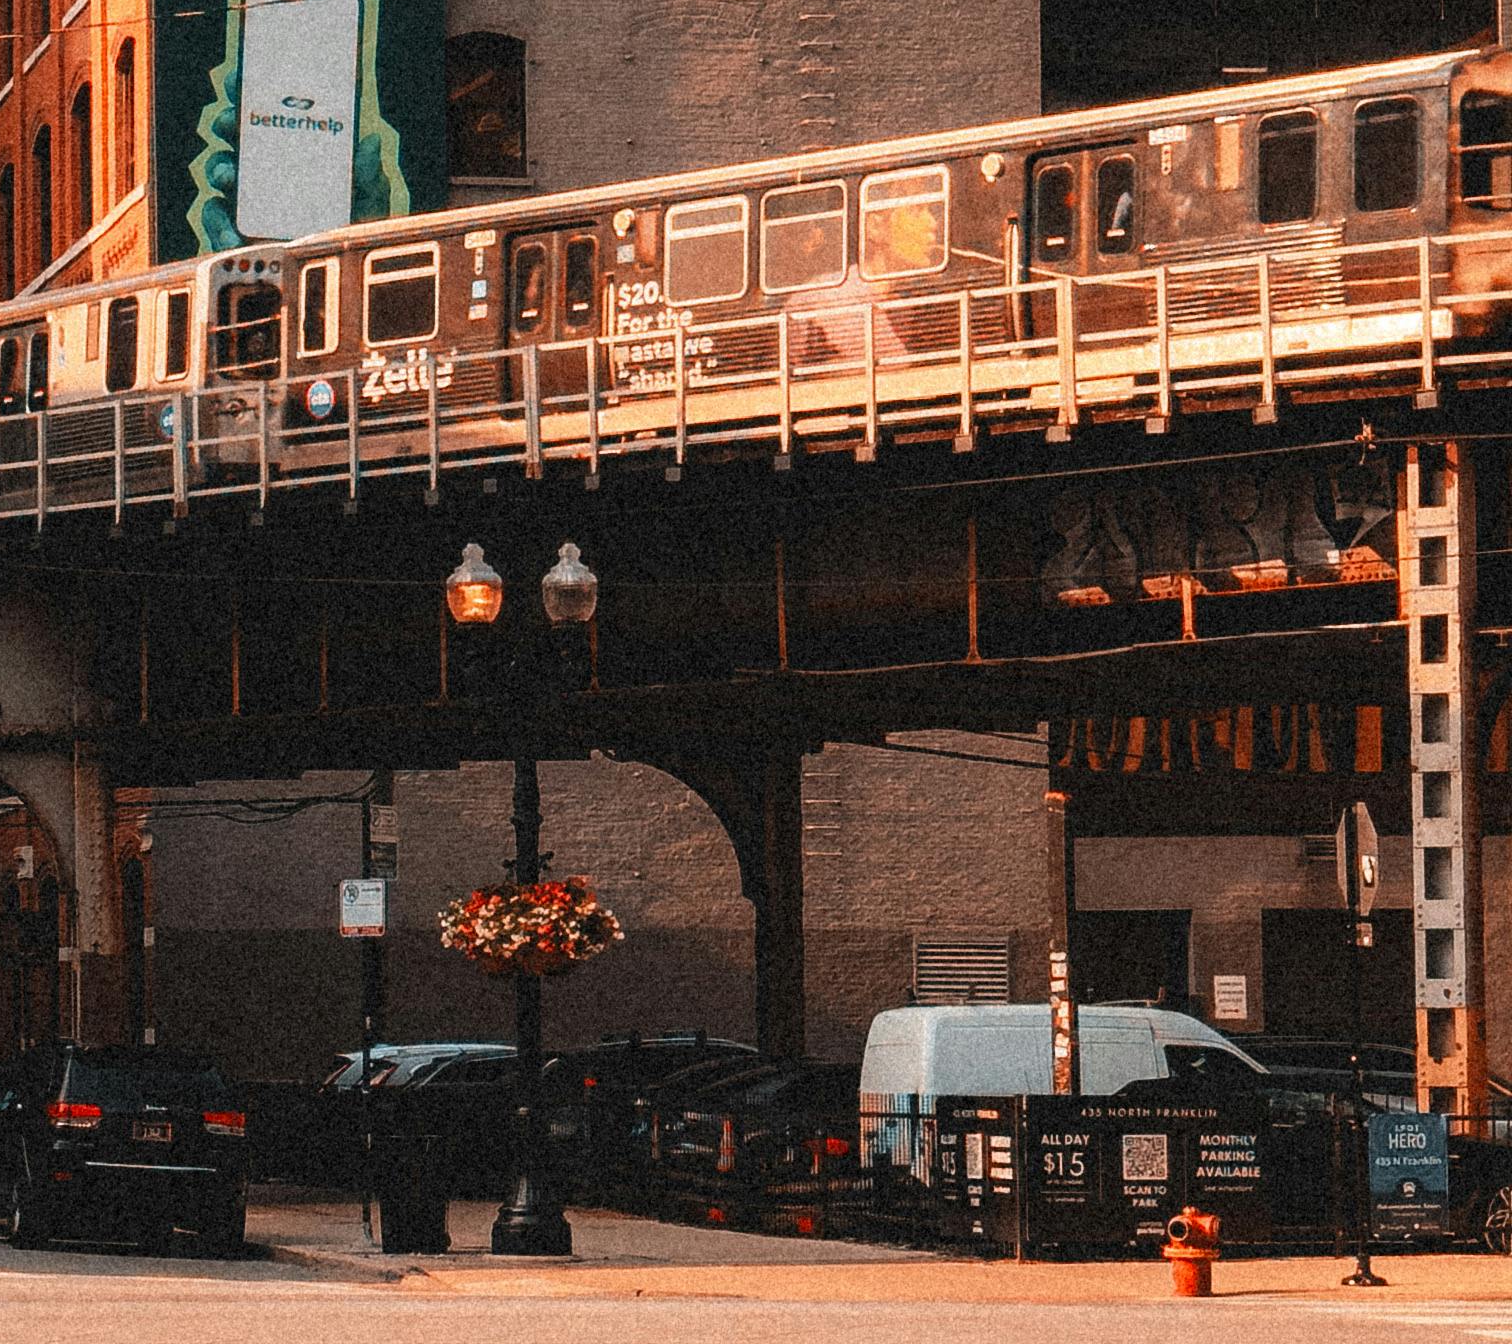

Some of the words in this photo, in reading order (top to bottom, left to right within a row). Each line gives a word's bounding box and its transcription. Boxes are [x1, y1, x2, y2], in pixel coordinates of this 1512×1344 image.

[249, 112, 344, 136] betterhelp
[617, 280, 665, 310] $20.
[616, 312, 654, 335] For
[656, 307, 694, 329] the
[684, 336, 714, 356] we
[361, 347, 455, 403] Zelle
[1080, 1107, 1103, 1118] 435
[1107, 1107, 1151, 1118] NORTH
[1155, 1107, 1218, 1118] FRANKLIN
[1040, 1133, 1062, 1146] ALL
[1064, 1133, 1091, 1146] DAY
[1199, 1134, 1258, 1146] MONTHLY
[1387, 1132, 1427, 1150] HERO
[1200, 1150, 1257, 1162] PARKING
[1043, 1151, 1086, 1177] $15
[1196, 1166, 1262, 1178] AVAILABLE
[1123, 1185, 1153, 1196] SCAN
[1153, 1185, 1168, 1196] TO
[1131, 1197, 1159, 1208] PARK
